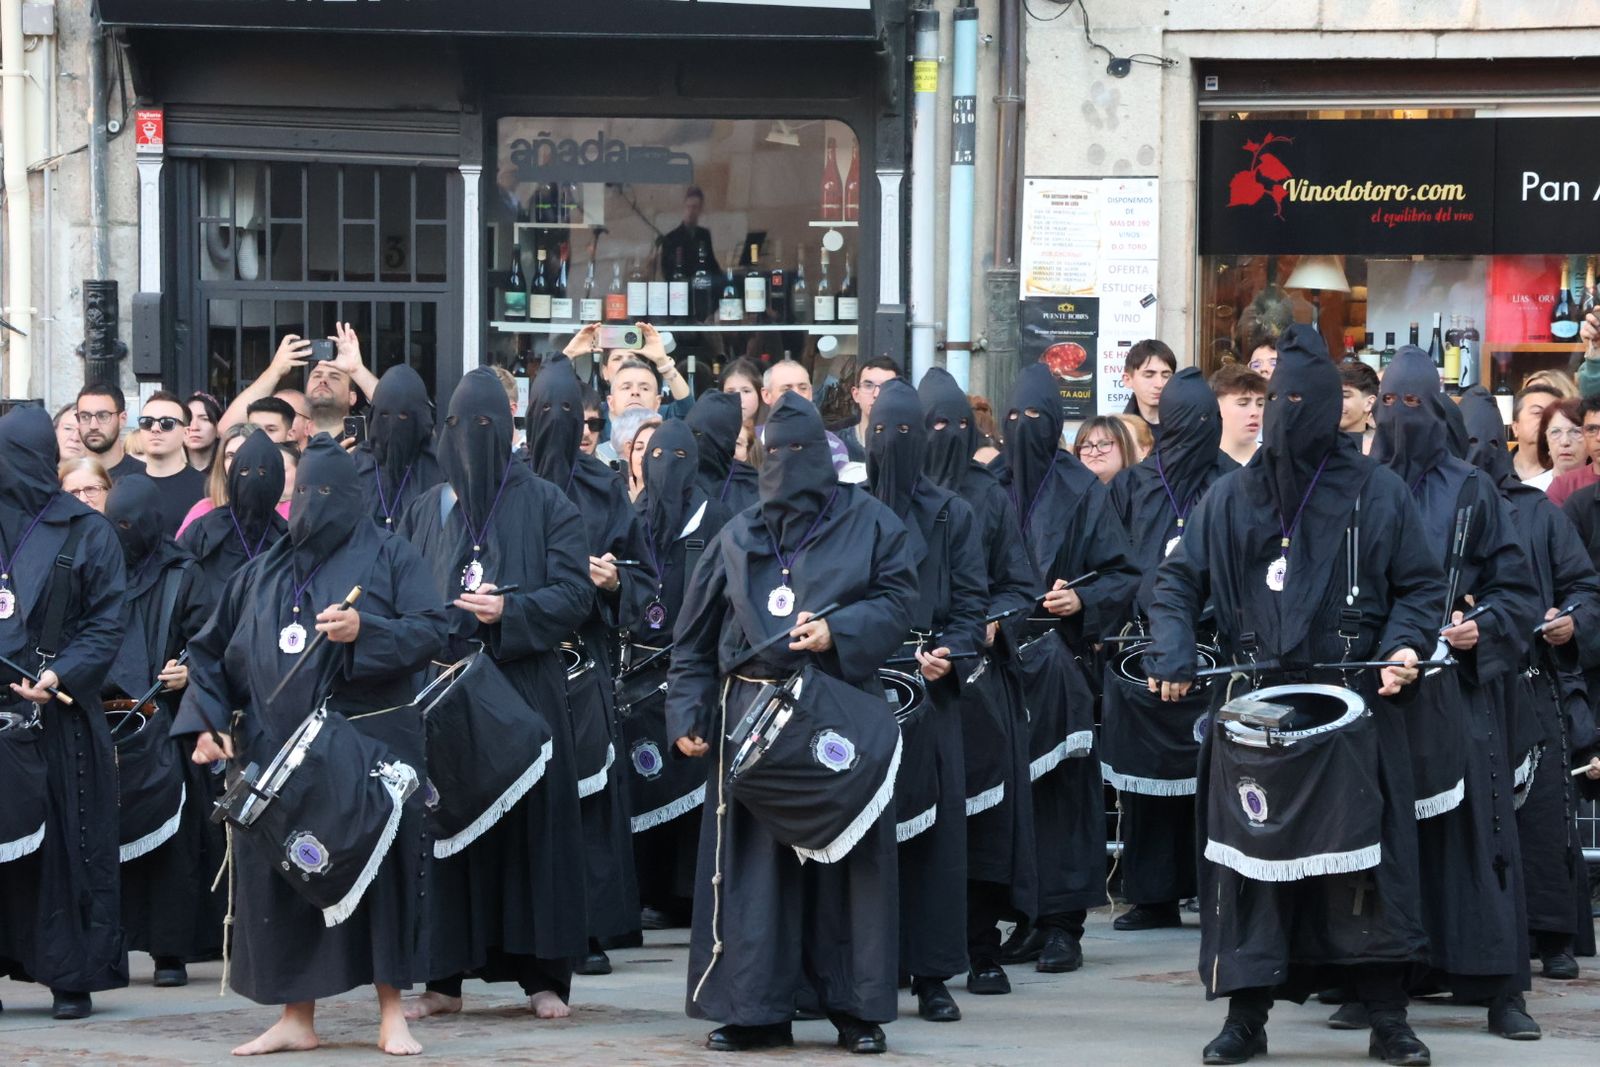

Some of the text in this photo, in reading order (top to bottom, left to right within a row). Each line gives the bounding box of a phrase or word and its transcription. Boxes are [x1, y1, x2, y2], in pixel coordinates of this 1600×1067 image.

[955, 99, 973, 110] CT
[953, 112, 975, 124] 610
[510, 130, 627, 167] añada
[1283, 178, 1466, 202] Vinodotoro.com
[1521, 171, 1580, 202] Pan
[1107, 196, 1153, 204] DISPONEMOS
[1370, 207, 1474, 228] el equilibrio del vino
[1108, 264, 1150, 275] OFERTA
[1102, 282, 1154, 293] ESTUCHES
[1114, 313, 1141, 323] VINO
[1103, 350, 1113, 359] SE
